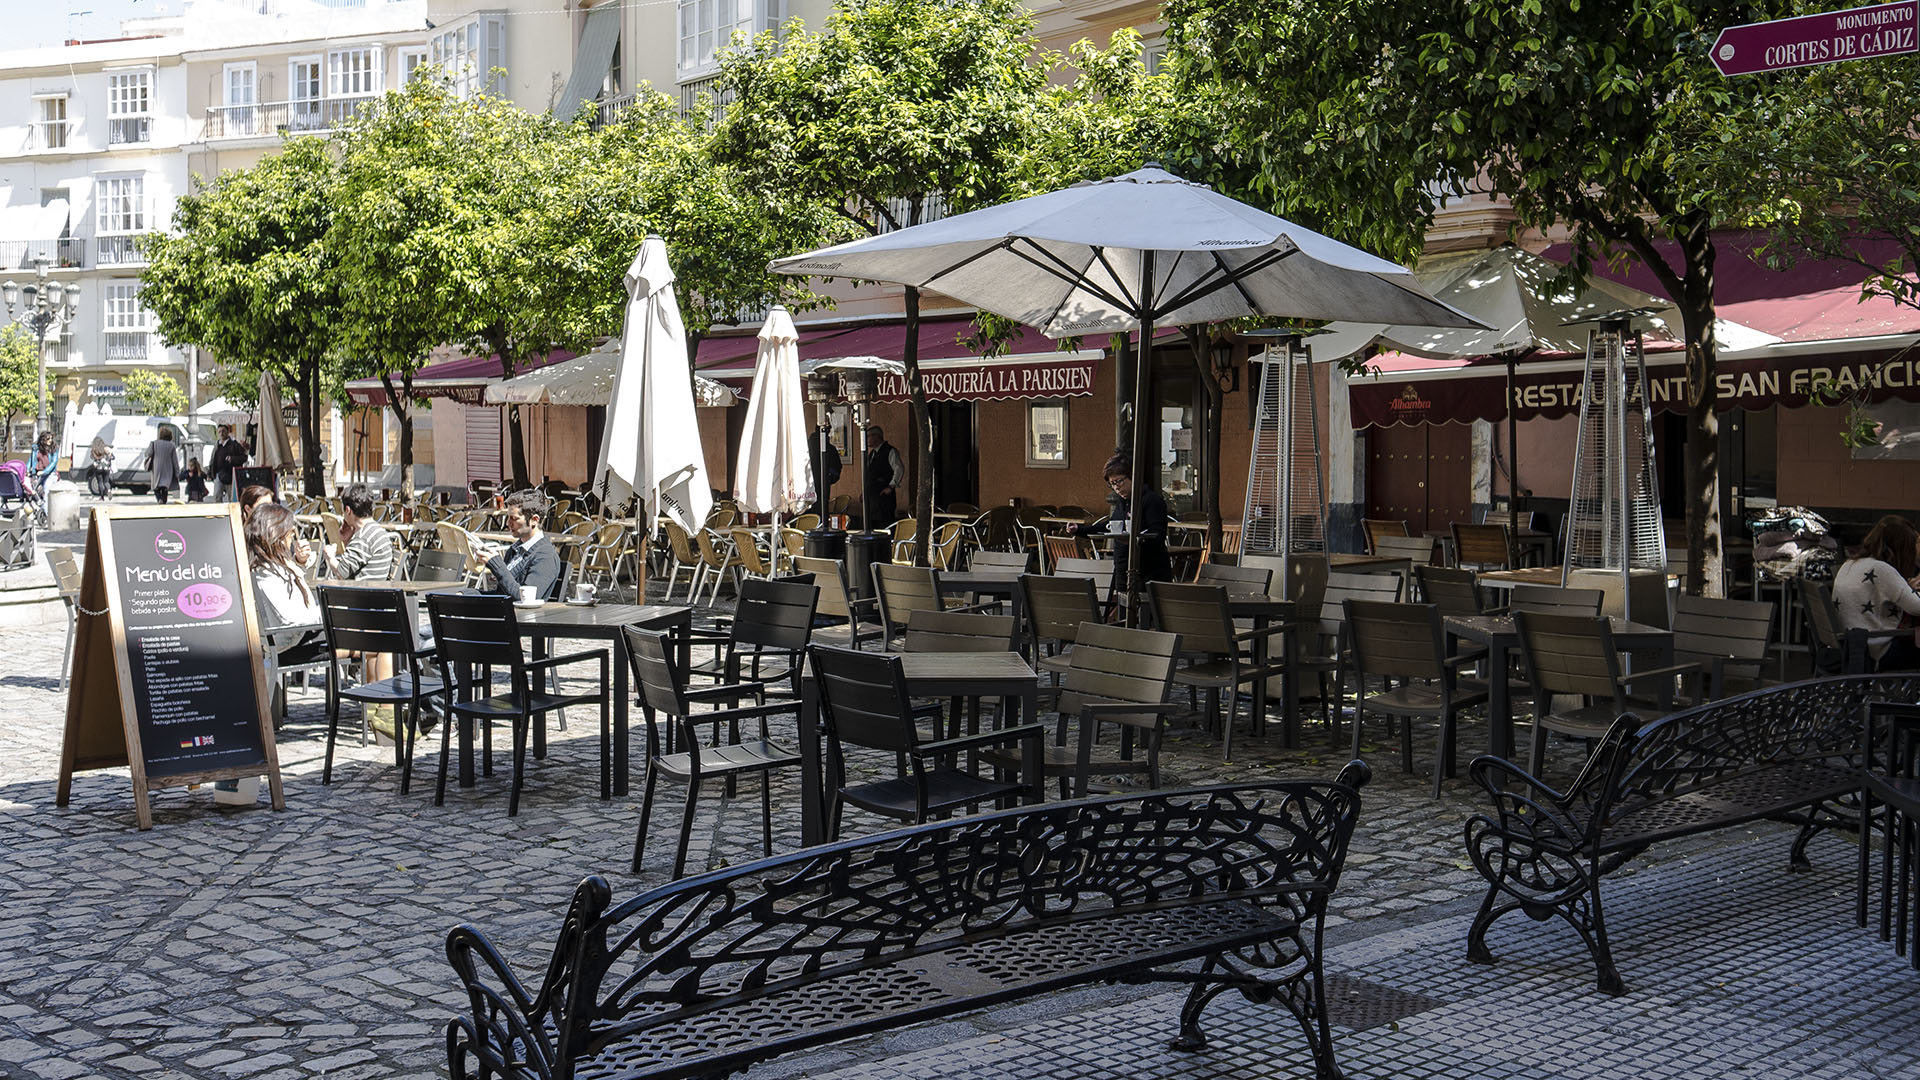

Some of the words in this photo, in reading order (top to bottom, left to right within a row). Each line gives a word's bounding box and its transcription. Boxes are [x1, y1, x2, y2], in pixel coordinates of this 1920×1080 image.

[1836, 7, 1913, 31] MONUMENTO
[1765, 39, 1829, 66] CORTES
[1834, 35, 1857, 58] DE
[1860, 27, 1914, 54] CÁDIZ
[899, 368, 995, 397] MRISQUERÍA
[999, 370, 1018, 392] LA
[1022, 366, 1093, 391] PARISIEN
[1506, 377, 1688, 409] RESTAUANT
[1716, 370, 1780, 398] SAN
[1389, 396, 1431, 410] Alhambra
[125, 565, 169, 583] Menú
[172, 563, 195, 581] del
[131, 598, 158, 608] Segundo
[159, 597, 174, 606] plato
[154, 589, 169, 597] plato
[131, 607, 151, 615] bebida
[157, 606, 177, 615] postre
